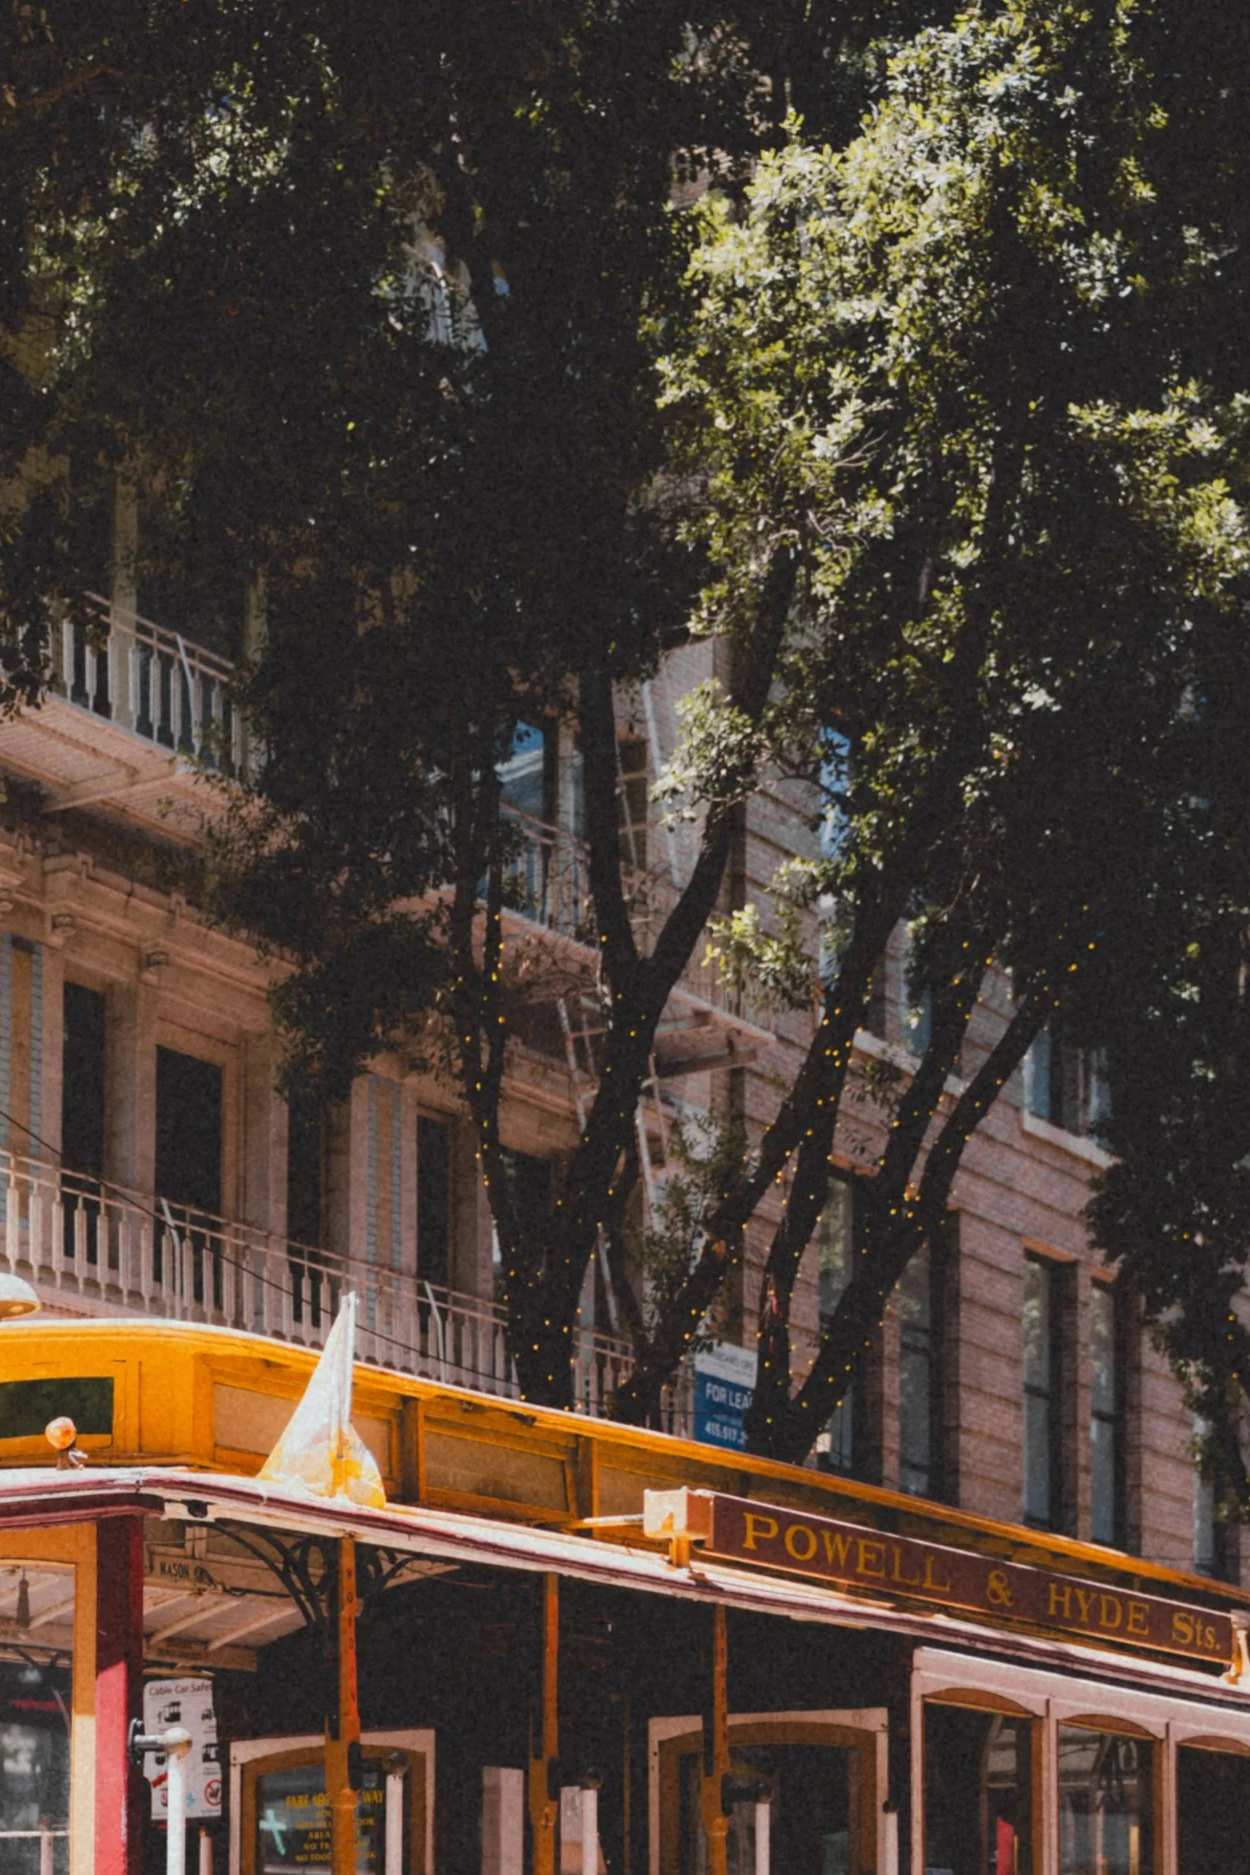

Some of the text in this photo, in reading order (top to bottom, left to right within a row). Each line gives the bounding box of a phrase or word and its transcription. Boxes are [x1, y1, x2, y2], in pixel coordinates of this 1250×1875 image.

[706, 1382, 726, 1404] FOR
[742, 1511, 1222, 1651] POWELL & HYDE Sts.
[149, 1686, 172, 1695] Cable
[175, 1684, 189, 1694] Car
